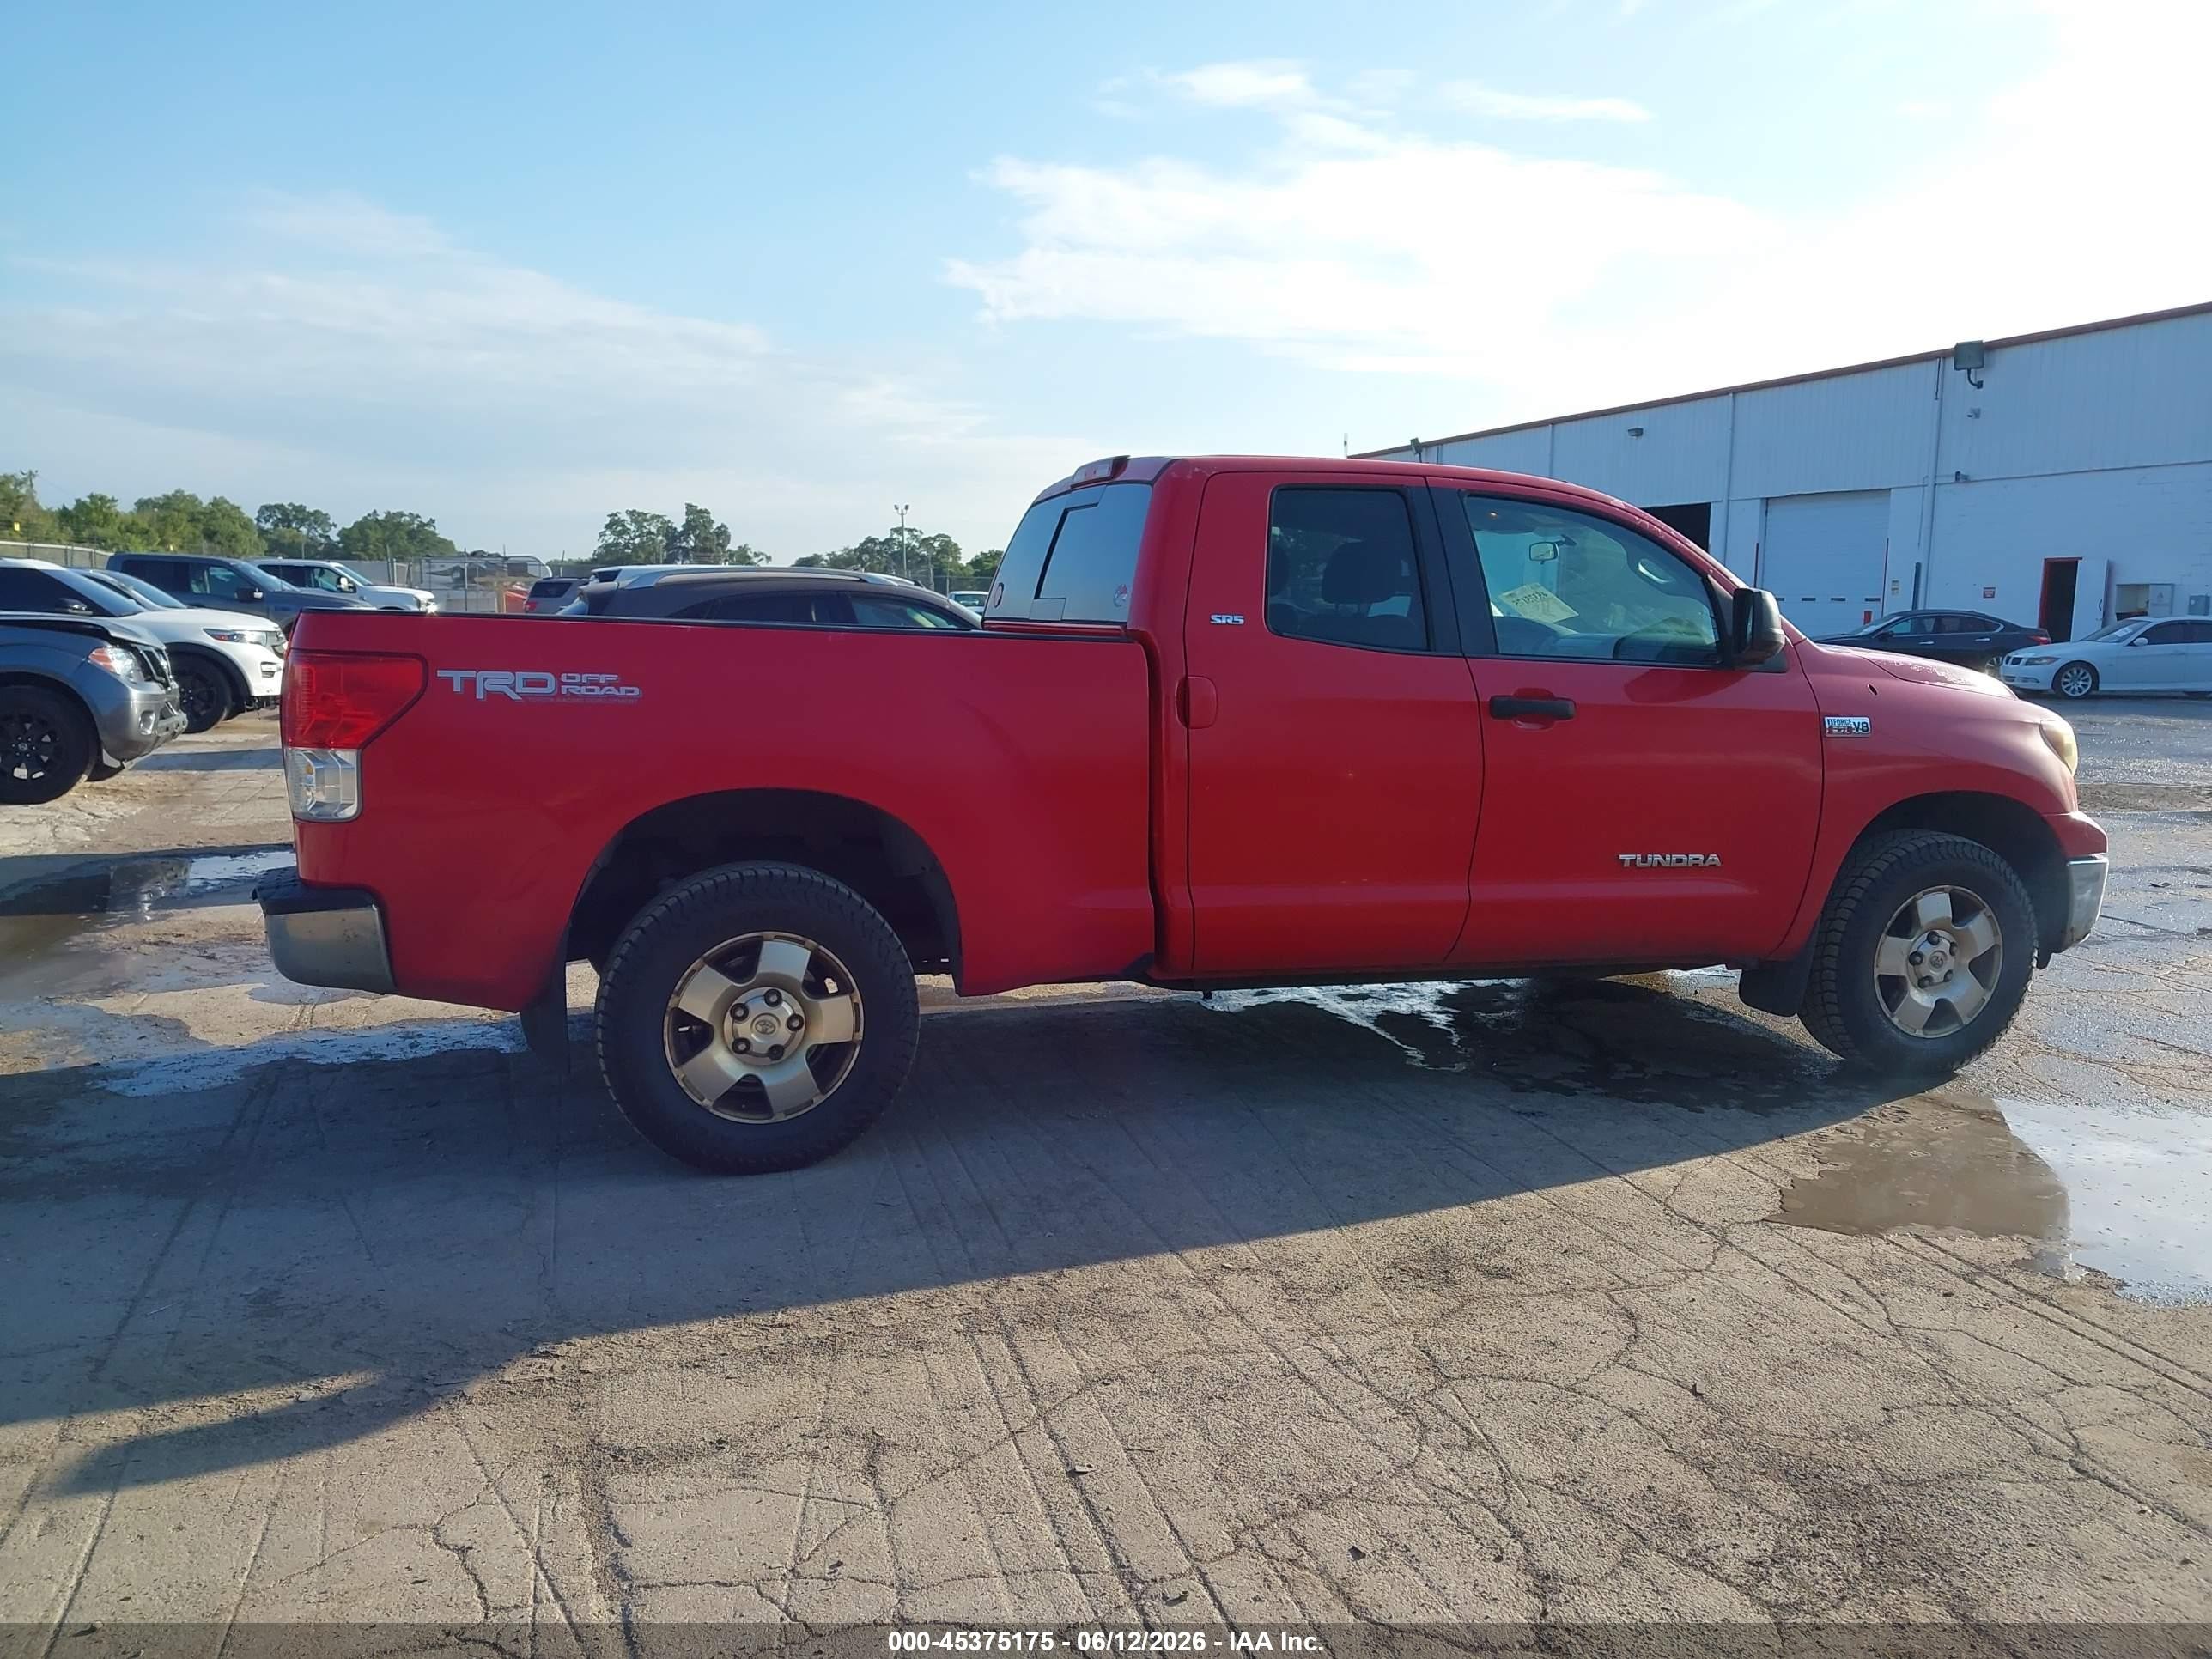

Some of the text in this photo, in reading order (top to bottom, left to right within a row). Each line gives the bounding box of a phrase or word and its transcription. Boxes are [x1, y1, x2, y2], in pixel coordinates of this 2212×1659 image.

[1210, 614, 1244, 625] SR5
[561, 672, 618, 684] OFF
[437, 670, 556, 700] TRD
[561, 685, 641, 697] ROAD
[1852, 721, 1869, 732] V8
[1619, 854, 1721, 867] TUNDRA
